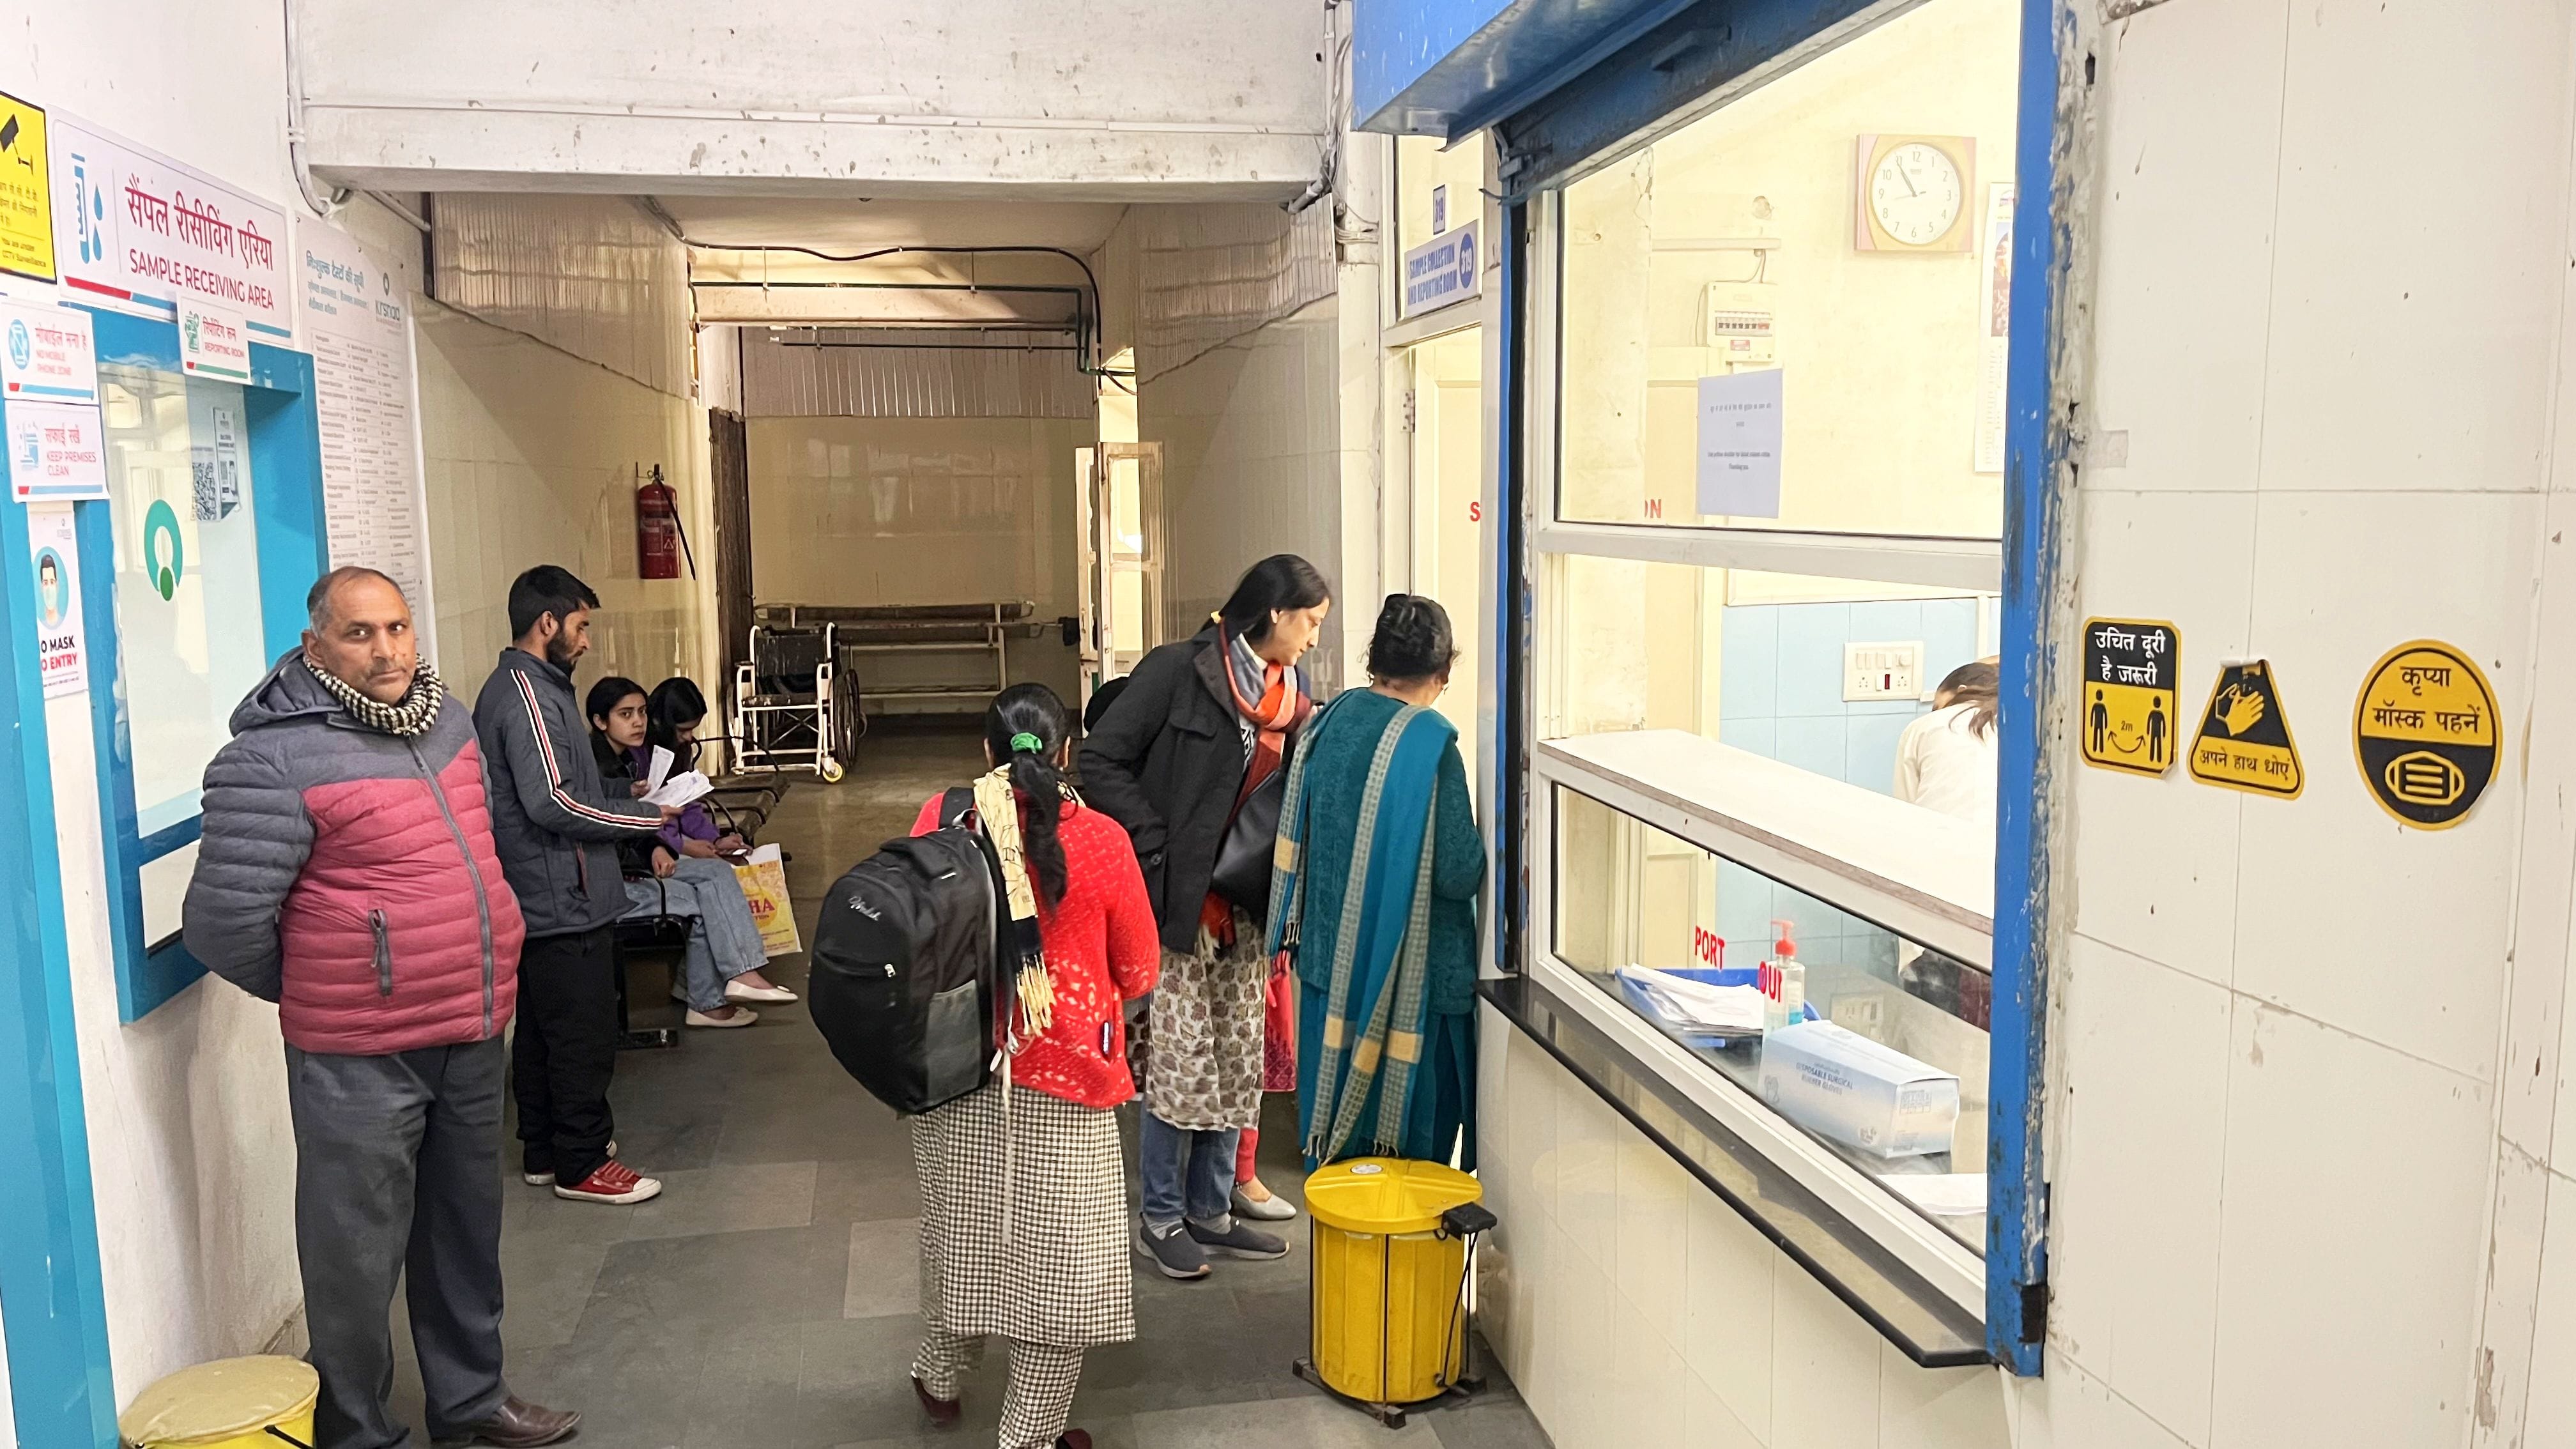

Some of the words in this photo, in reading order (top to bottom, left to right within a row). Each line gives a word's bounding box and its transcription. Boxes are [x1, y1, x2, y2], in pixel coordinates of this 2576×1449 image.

[1912, 151, 1920, 162] 12
[1883, 169, 1892, 180] 10
[1943, 171, 1948, 182] 2
[1878, 188, 1884, 199] 9
[1947, 190, 1952, 201] 3
[1882, 208, 1888, 218] 8
[1941, 210, 1947, 219] 4
[125, 172, 169, 236] सैंपल
[174, 190, 234, 258] रीसीविंग
[237, 219, 273, 271] एरिया
[1895, 222, 1900, 233] 7
[1929, 222, 1933, 233] 5
[1911, 227, 1917, 238] 6
[1410, 256, 1427, 279] SAMPLE
[1428, 242, 1455, 272] COLLECTION
[1460, 248, 1472, 275] 319
[130, 249, 182, 286] SAMPLE
[185, 265, 245, 302] RECEIVING
[248, 284, 274, 310] AREA
[204, 342, 230, 355] REPORTING
[47, 451, 63, 461] KEEP
[65, 451, 96, 463] PREMISES
[48, 464, 69, 476] CLEAN
[41, 640, 47, 653] O
[50, 635, 75, 652] MASK
[2094, 627, 2136, 650] उचित
[2141, 629, 2166, 659] दूरी
[41, 658, 47, 671] O
[50, 652, 77, 670] ENTRY
[2100, 656, 2112, 681] है
[2117, 661, 2158, 686] जरूरी
[2400, 666, 2451, 696] कृप्या
[2372, 699, 2426, 729] मॉस्क
[2434, 704, 2480, 733] पहनें
[2120, 720, 2133, 732] 2m
[2200, 746, 2228, 767] अपने
[2233, 755, 2258, 772] हाथ
[2264, 755, 2290, 781] धोएं
[748, 898, 775, 914] HA
[1694, 925, 1725, 970] PORT
[1828, 1074, 1853, 1090] SURGICAL
